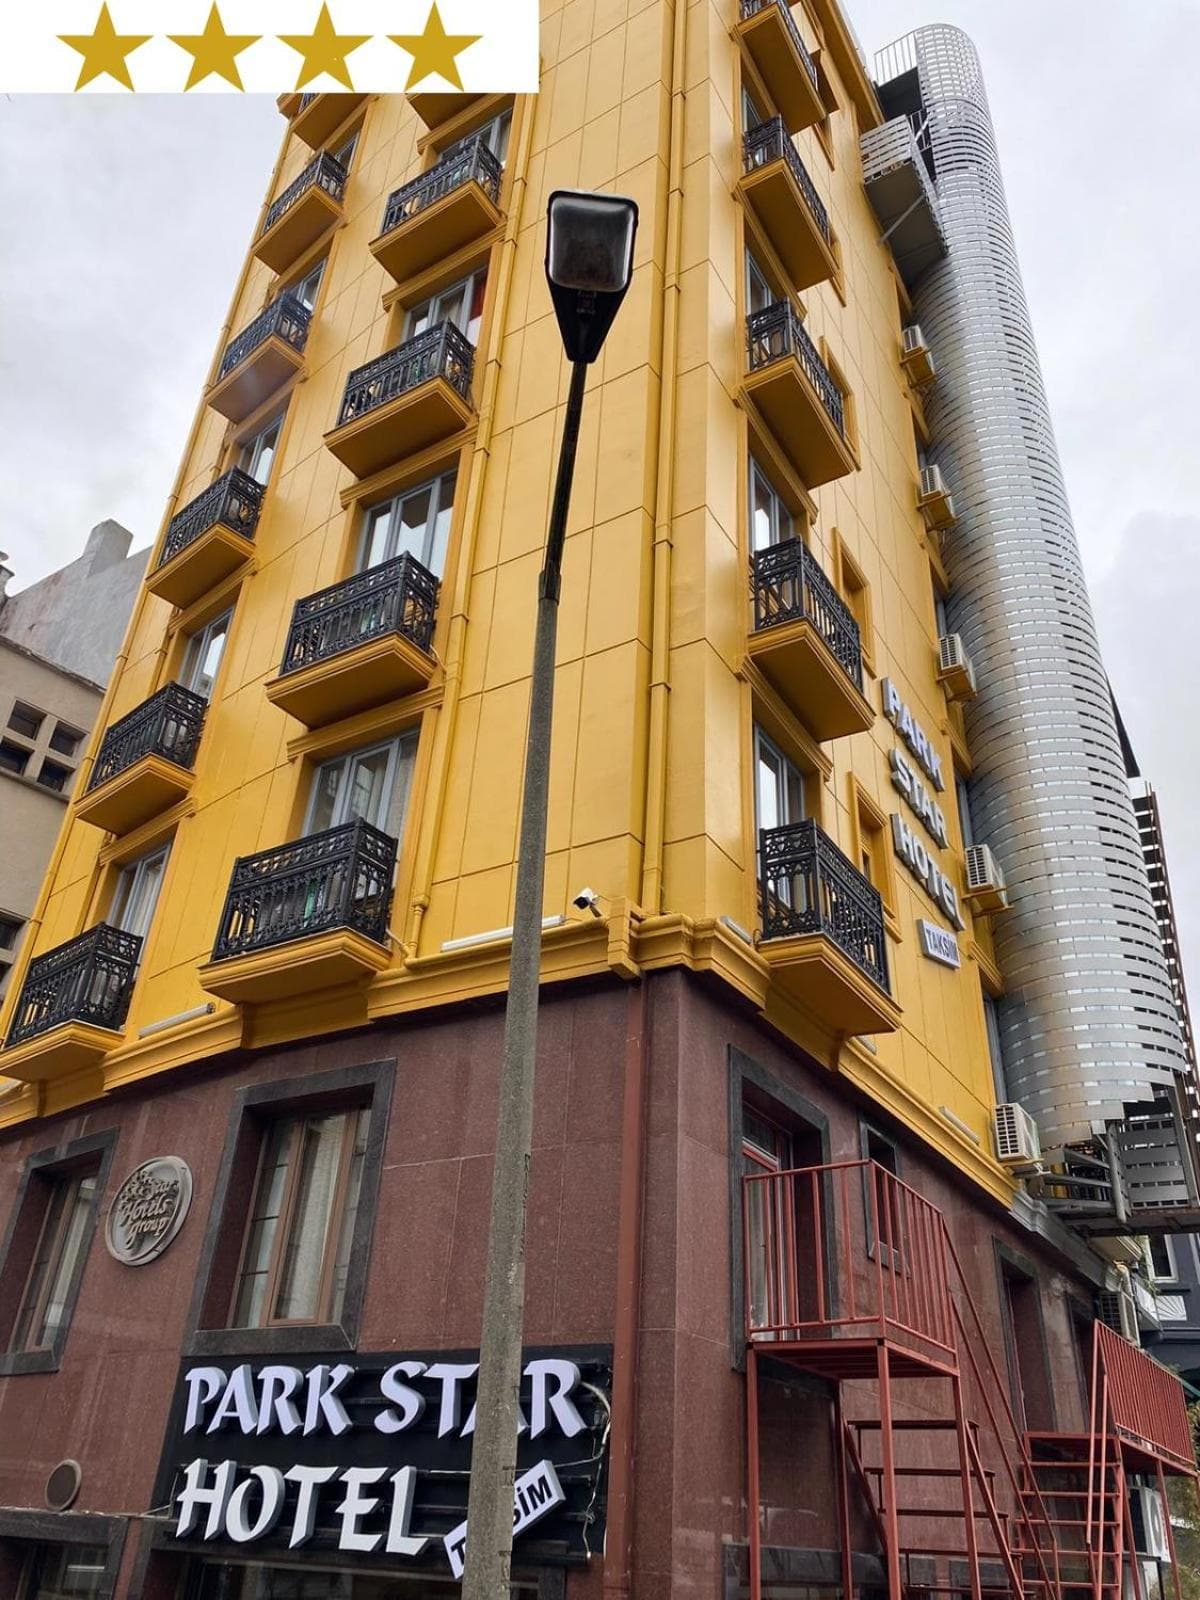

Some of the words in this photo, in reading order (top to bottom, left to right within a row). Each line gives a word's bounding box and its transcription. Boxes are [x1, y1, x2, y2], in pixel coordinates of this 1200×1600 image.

[882, 677, 944, 792] PARK
[889, 748, 948, 849] STAR
[890, 813, 965, 931] HOTEL
[184, 1363, 355, 1437] PARK
[374, 1360, 588, 1440] STR
[176, 1458, 429, 1556] HOTEL
